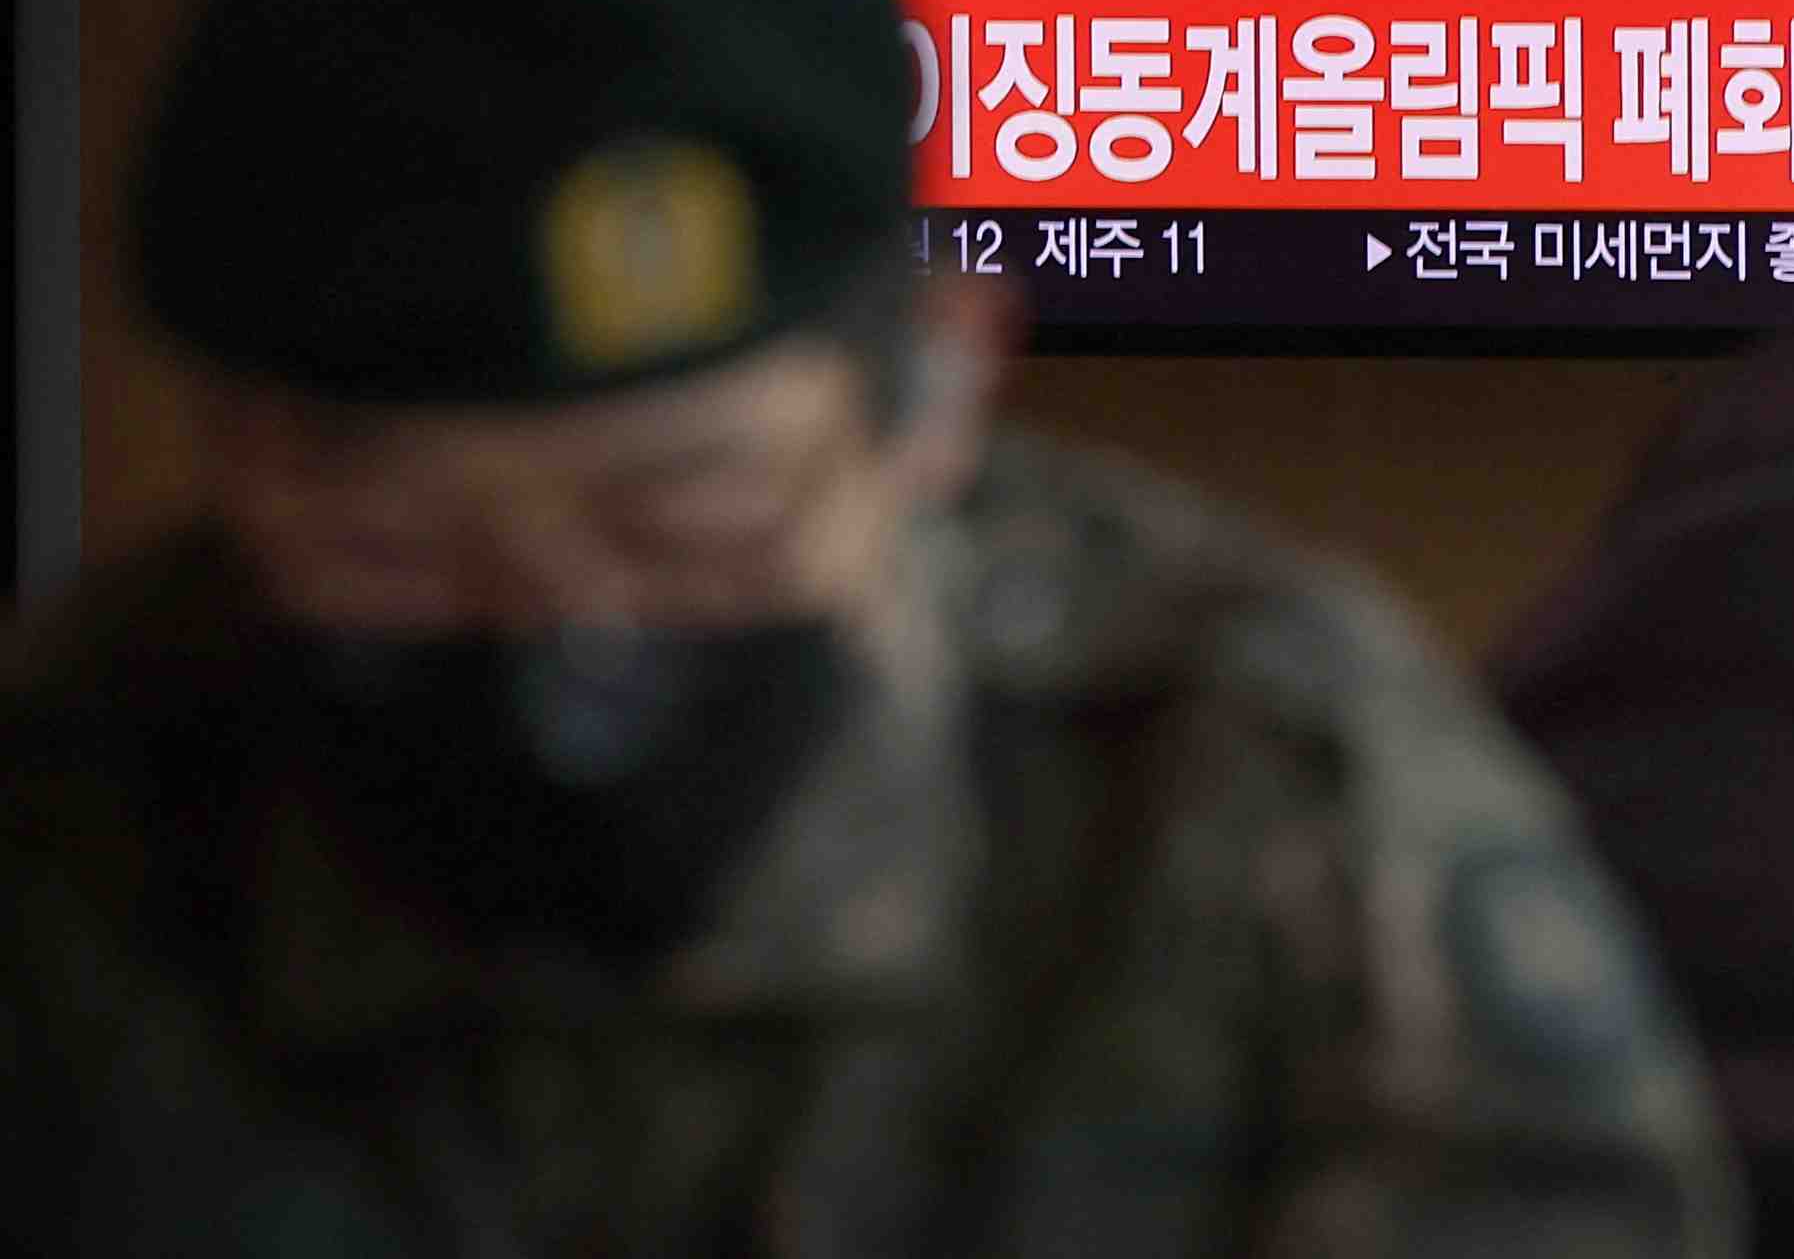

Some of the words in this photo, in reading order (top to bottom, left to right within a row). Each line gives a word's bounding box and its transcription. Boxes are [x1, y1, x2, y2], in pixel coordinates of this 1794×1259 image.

[952, 220, 1003, 274] 12
[1035, 217, 1145, 279] 제주
[1162, 221, 1204, 274] 11
[1406, 219, 1515, 281] 전국
[1534, 219, 1746, 282] 미세먼지
